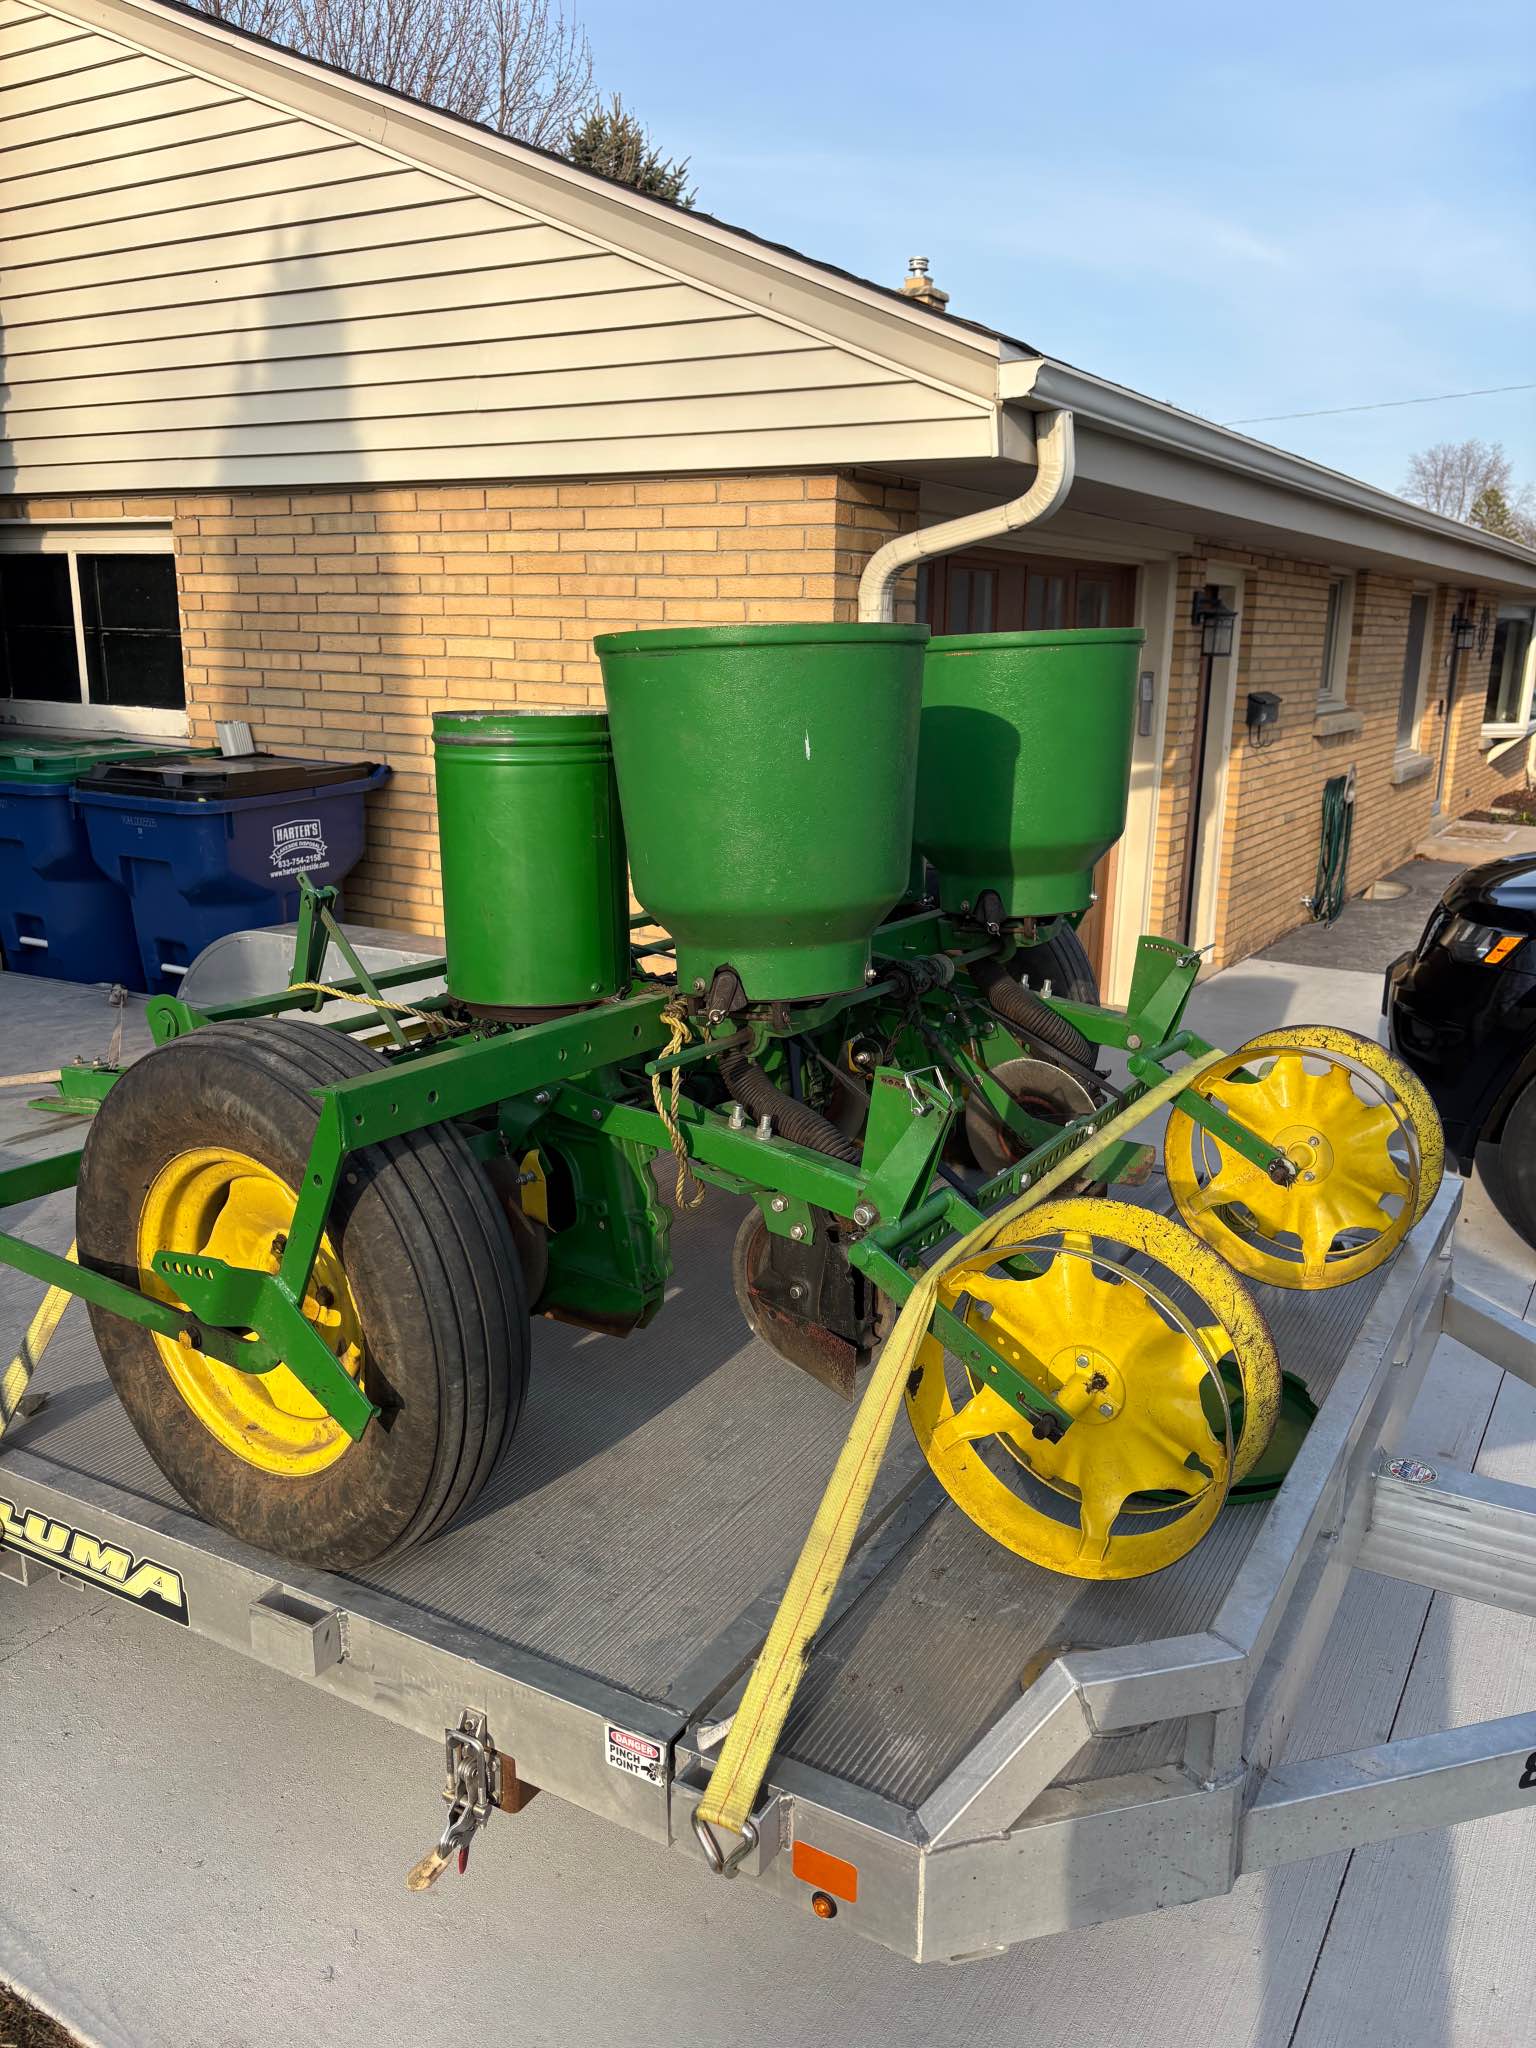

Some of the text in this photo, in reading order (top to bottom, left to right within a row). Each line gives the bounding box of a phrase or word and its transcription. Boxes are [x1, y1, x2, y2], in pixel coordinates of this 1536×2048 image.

[276, 823, 318, 842] HARTER'S
[277, 841, 321, 855] LAKESIDE DISPOSAL
[610, 1744, 640, 1764] PINCH
[615, 1732, 653, 1757] DANGER
[610, 1755, 640, 1773] POINT
